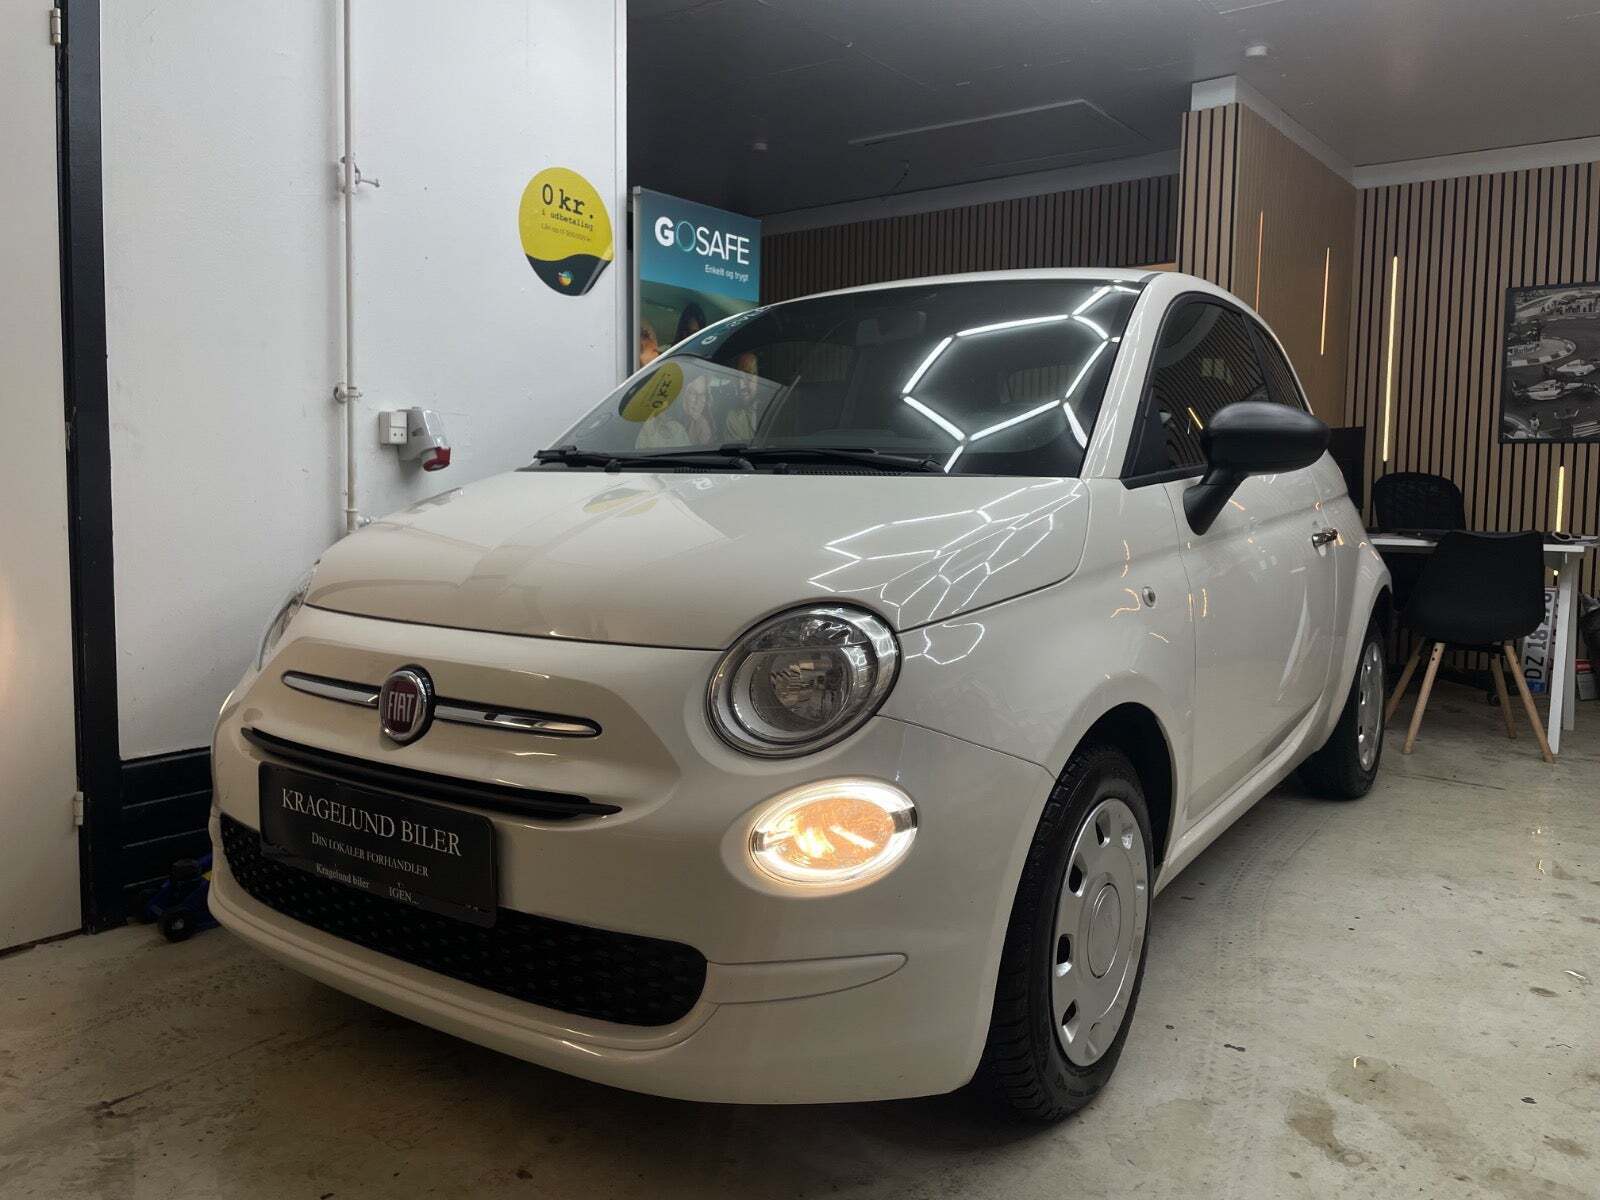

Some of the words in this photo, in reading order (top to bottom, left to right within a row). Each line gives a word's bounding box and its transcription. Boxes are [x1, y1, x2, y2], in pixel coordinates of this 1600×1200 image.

[542, 183, 554, 206] 0
[559, 188, 593, 219] kr.
[550, 211, 593, 232] udbetaling
[654, 216, 750, 266] GOSAFE
[725, 269, 735, 281] og
[735, 268, 749, 282] trygt
[1524, 655, 1544, 680] DZ
[386, 690, 416, 724] FIAT
[281, 788, 395, 838] KRAGELUND
[401, 820, 462, 857] BILER
[311, 832, 328, 848] DIN
[328, 839, 365, 859] LOKALER
[366, 851, 430, 879] FORHANDLER
[316, 863, 352, 884] Kragelund
[352, 875, 370, 889] biler
